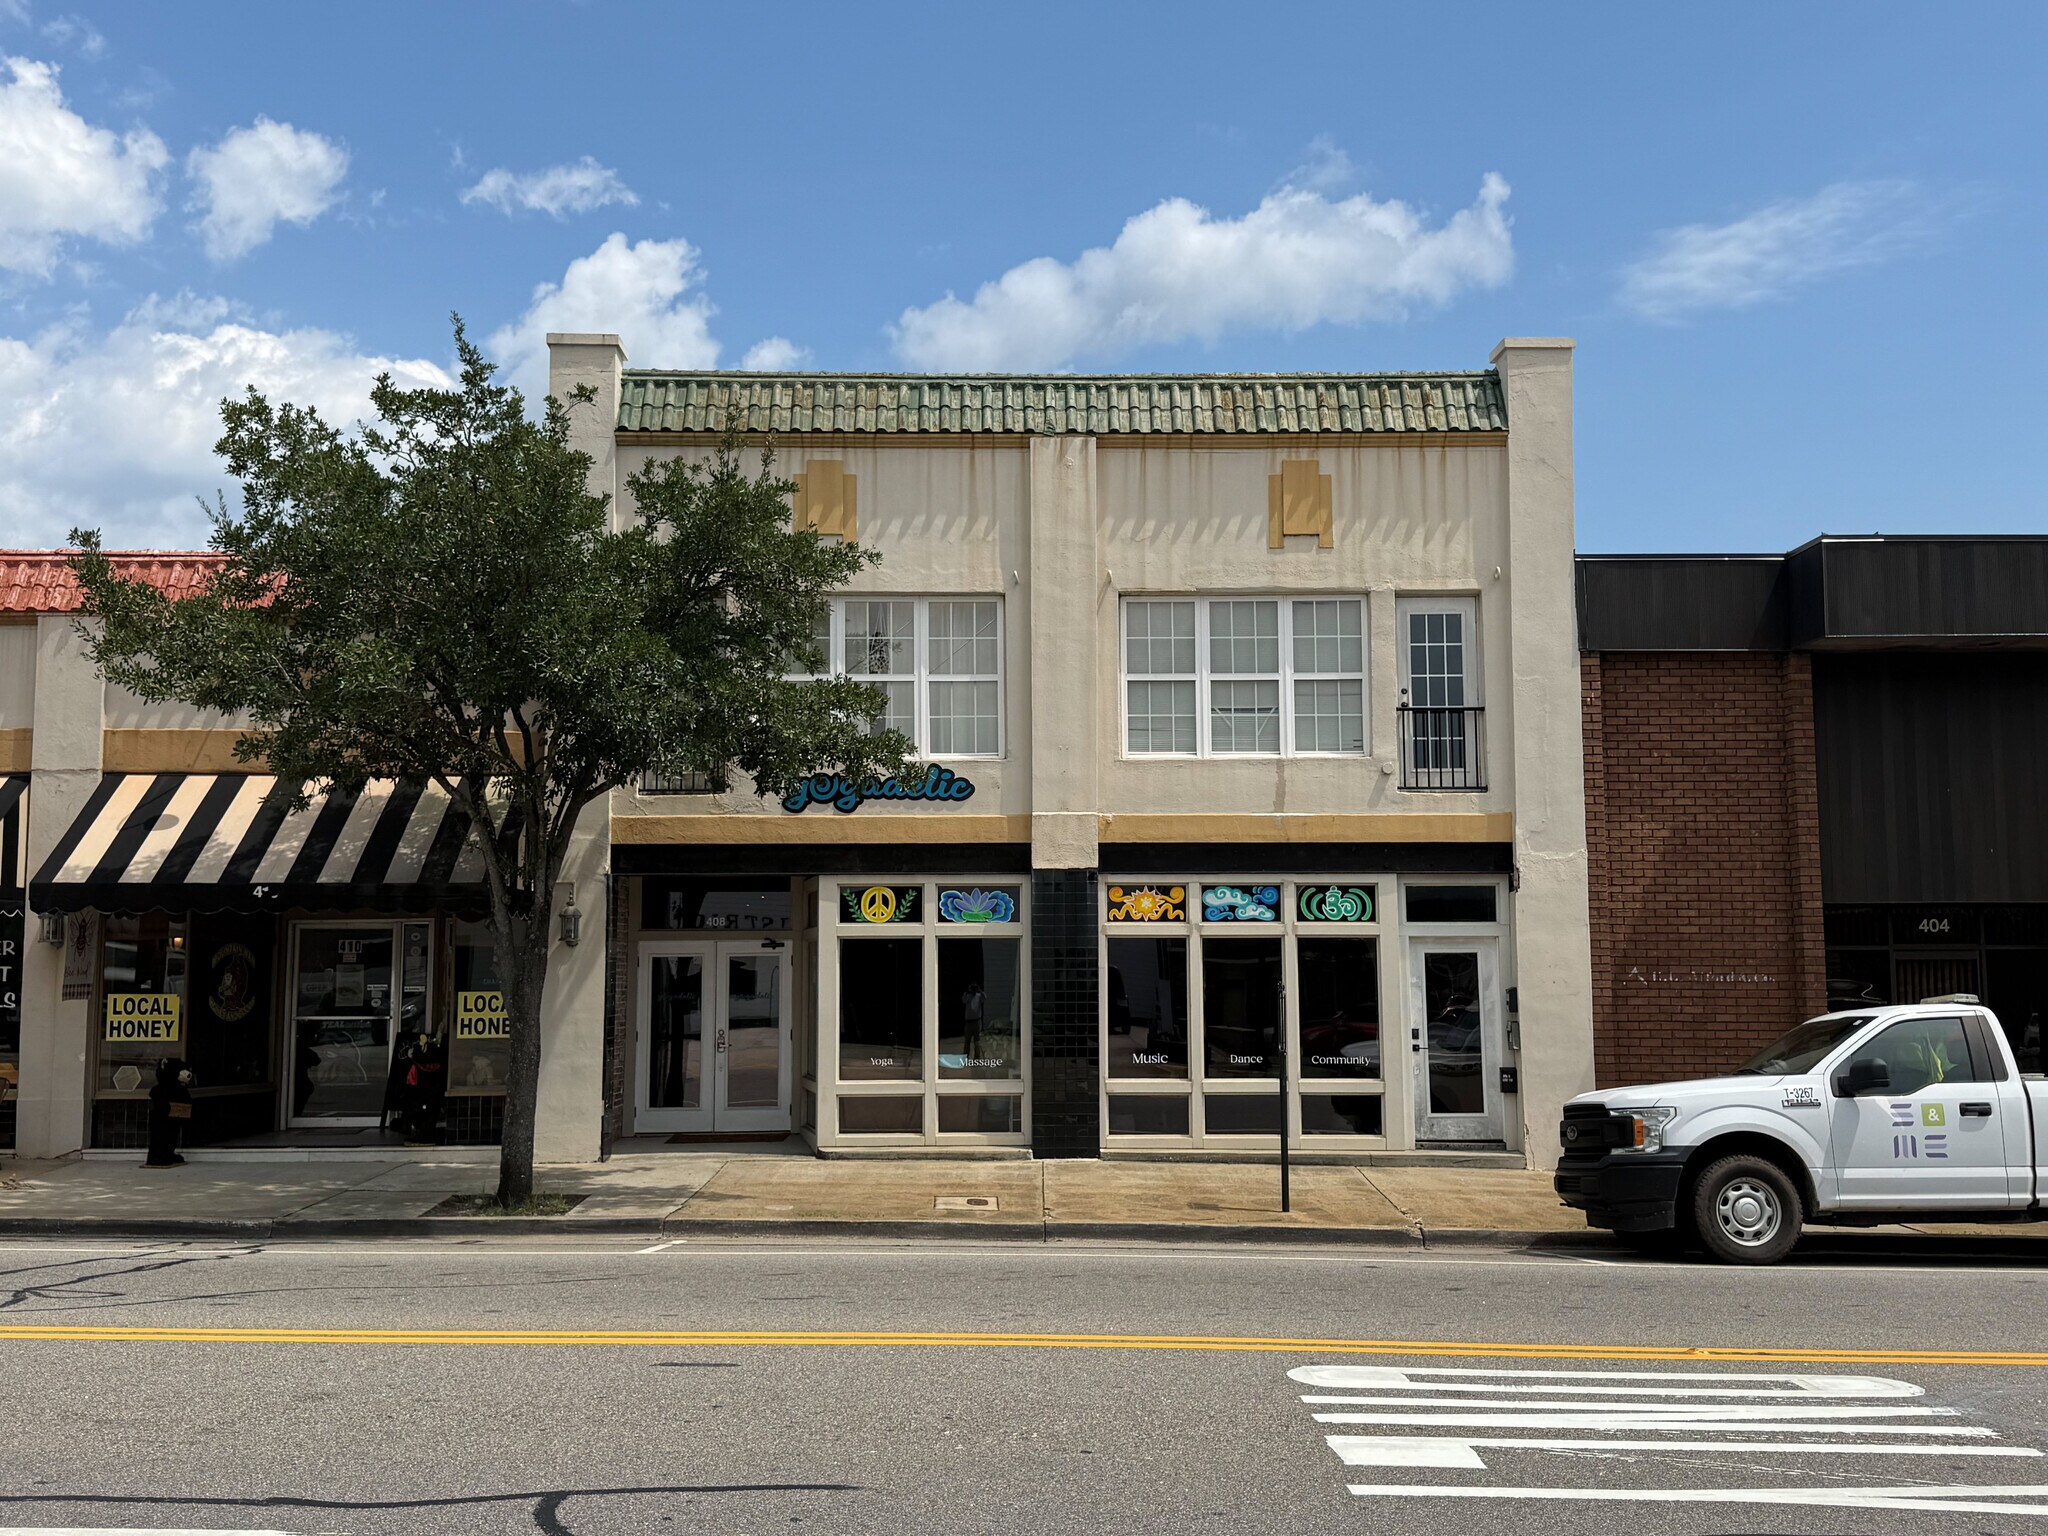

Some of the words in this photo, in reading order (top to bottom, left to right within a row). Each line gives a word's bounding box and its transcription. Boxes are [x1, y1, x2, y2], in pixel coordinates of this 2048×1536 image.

[706, 916, 726, 927] 408
[1918, 918, 1950, 933] 404
[0, 940, 16, 956] R
[339, 940, 362, 953] 410
[113, 997, 173, 1015] LOCAL
[109, 1020, 175, 1038] HONEY
[870, 1057, 893, 1067] Yoga
[959, 1057, 1003, 1068] Massage
[1132, 1052, 1169, 1064] Music
[1230, 1054, 1263, 1064] Dance
[1311, 1055, 1371, 1067] Community
[1783, 1087, 1813, 1099] T-3267
